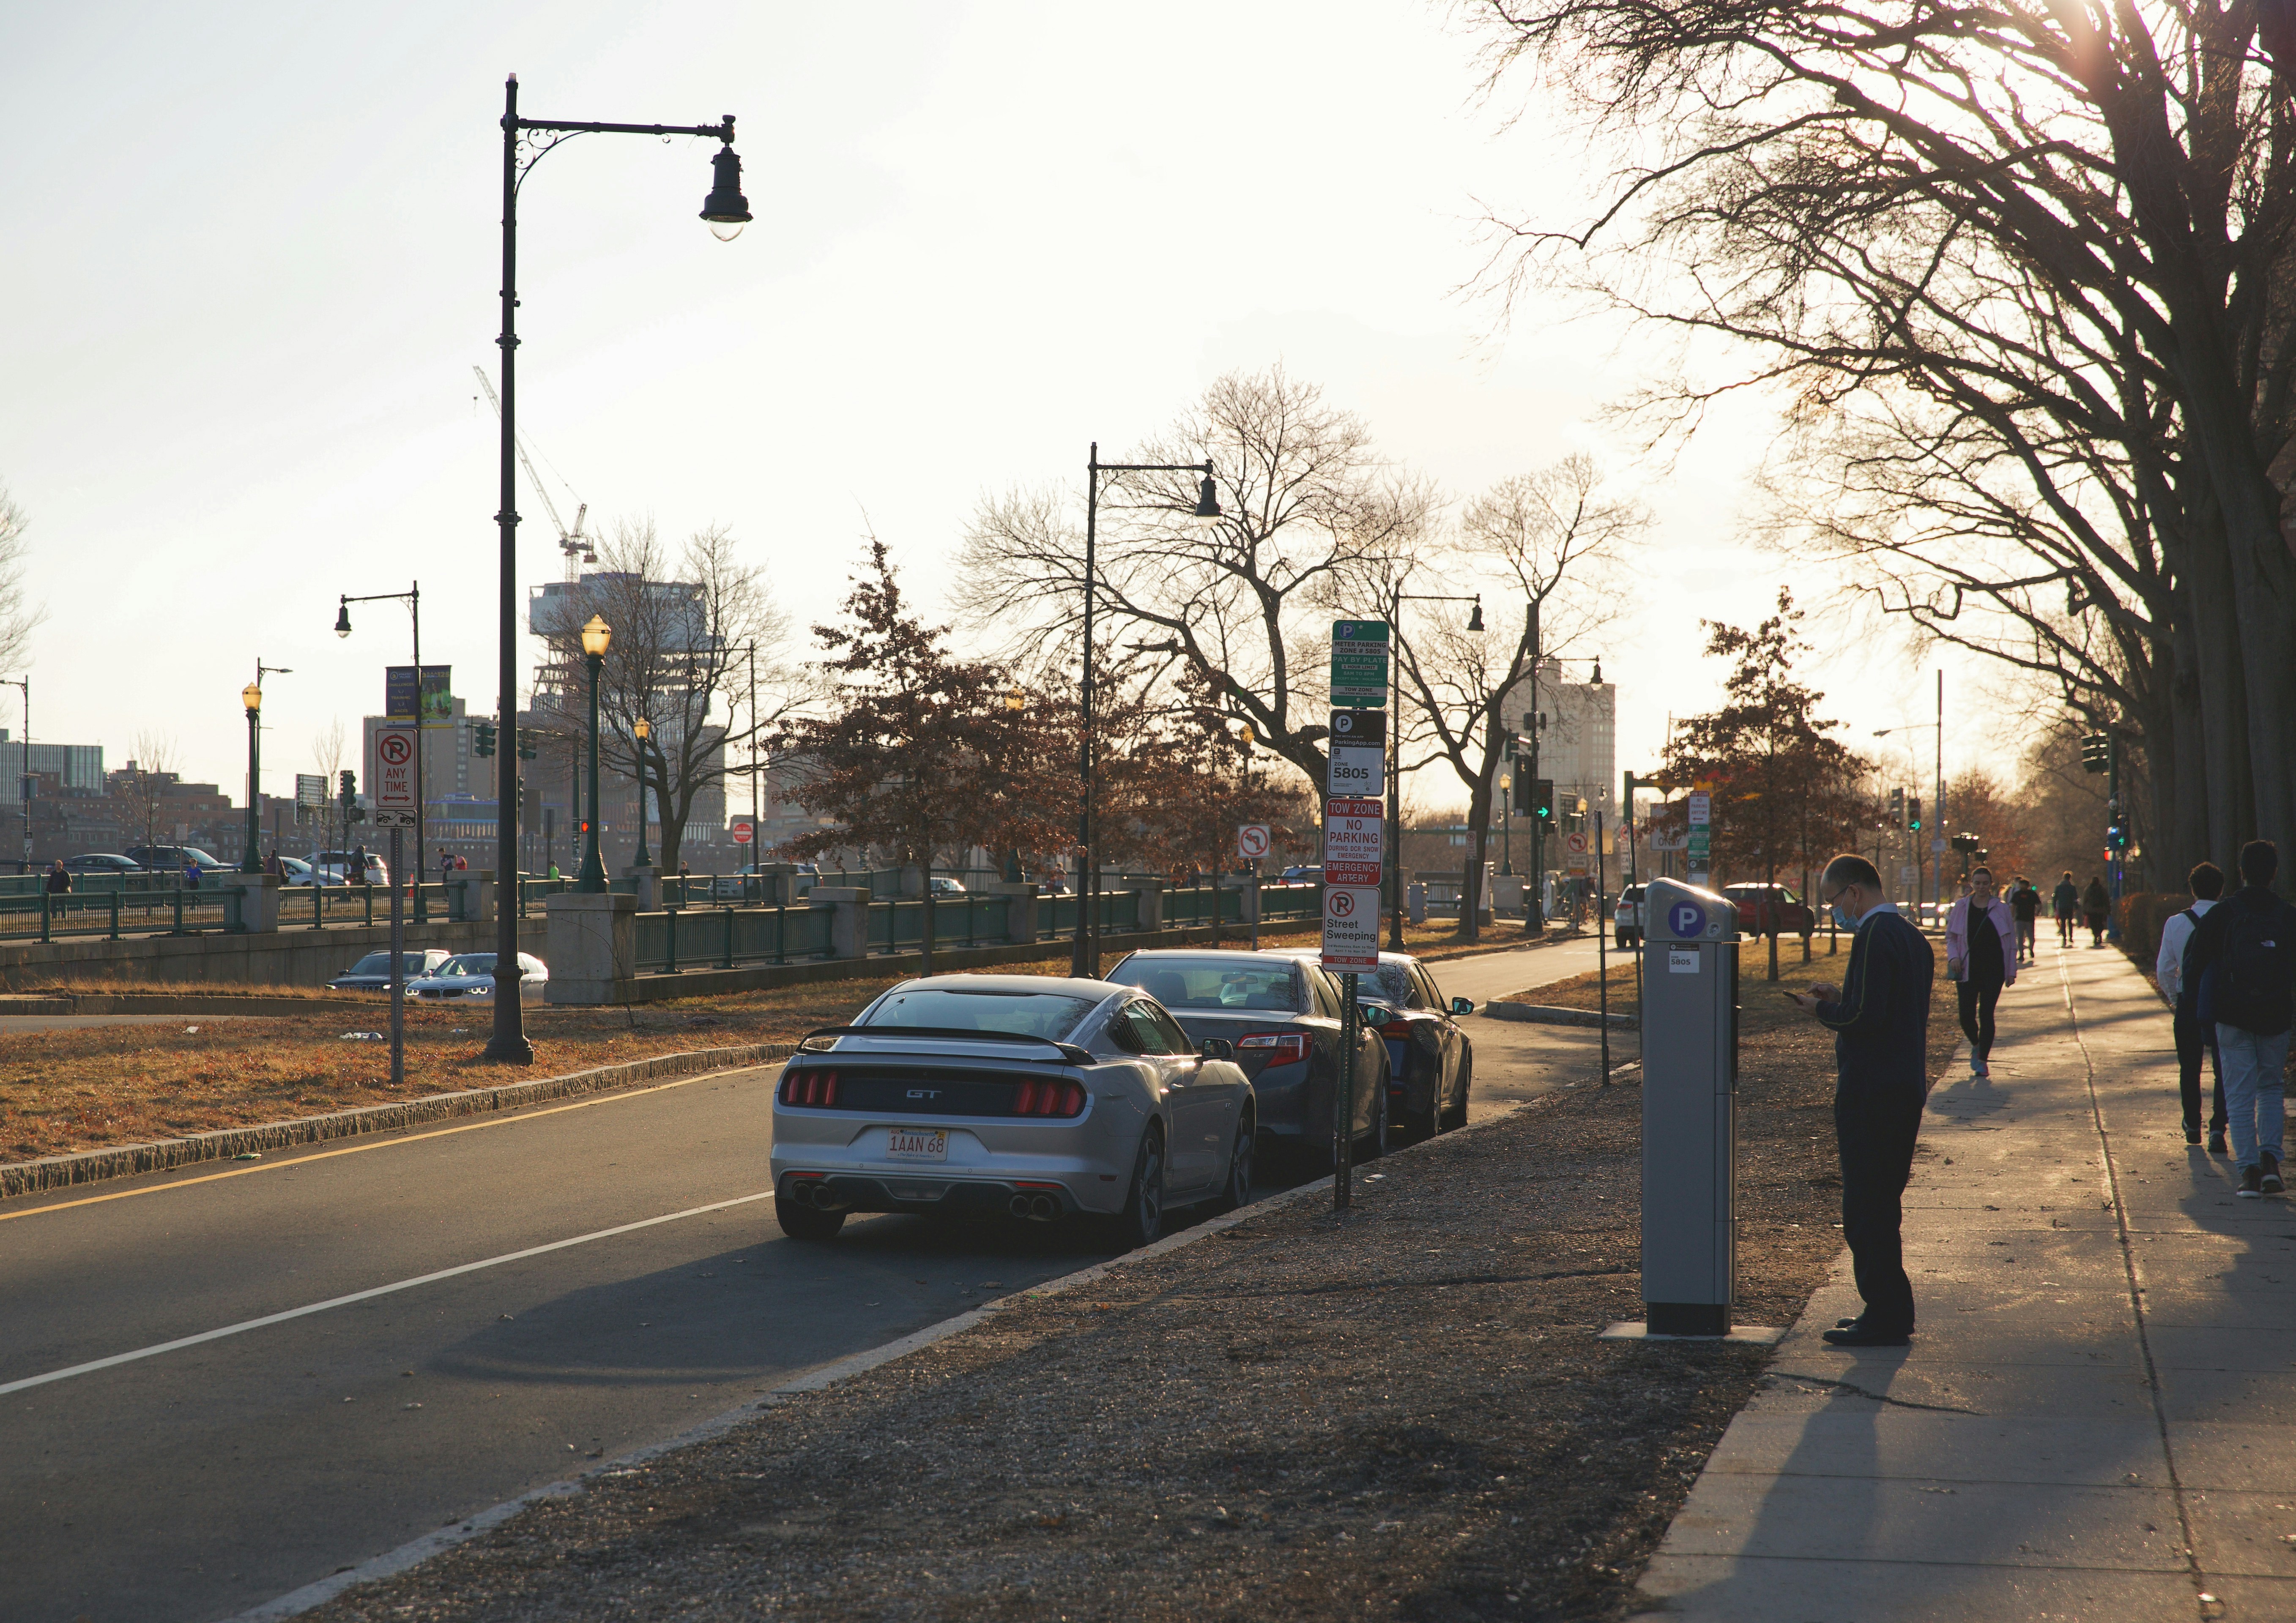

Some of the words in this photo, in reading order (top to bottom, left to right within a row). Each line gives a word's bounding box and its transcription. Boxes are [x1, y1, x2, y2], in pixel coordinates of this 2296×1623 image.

[1343, 626, 1353, 637] P
[386, 768, 406, 779] ANY
[1333, 768, 1369, 779] 5805
[385, 781, 408, 792] TIME
[1330, 803, 1350, 814] TOW
[1354, 803, 1380, 814] ZONE
[1346, 820, 1362, 830] NO
[1330, 832, 1378, 844] PARKING
[1327, 863, 1379, 872] EMERGENCY
[1337, 874, 1368, 882] ARTERY
[1327, 919, 1358, 928] Street
[1679, 907, 1697, 931] P
[1327, 930, 1376, 942] Sweeping
[907, 1090, 941, 1098] GT
[890, 1136, 924, 1151] 1AAN
[928, 1138, 944, 1153] 68
